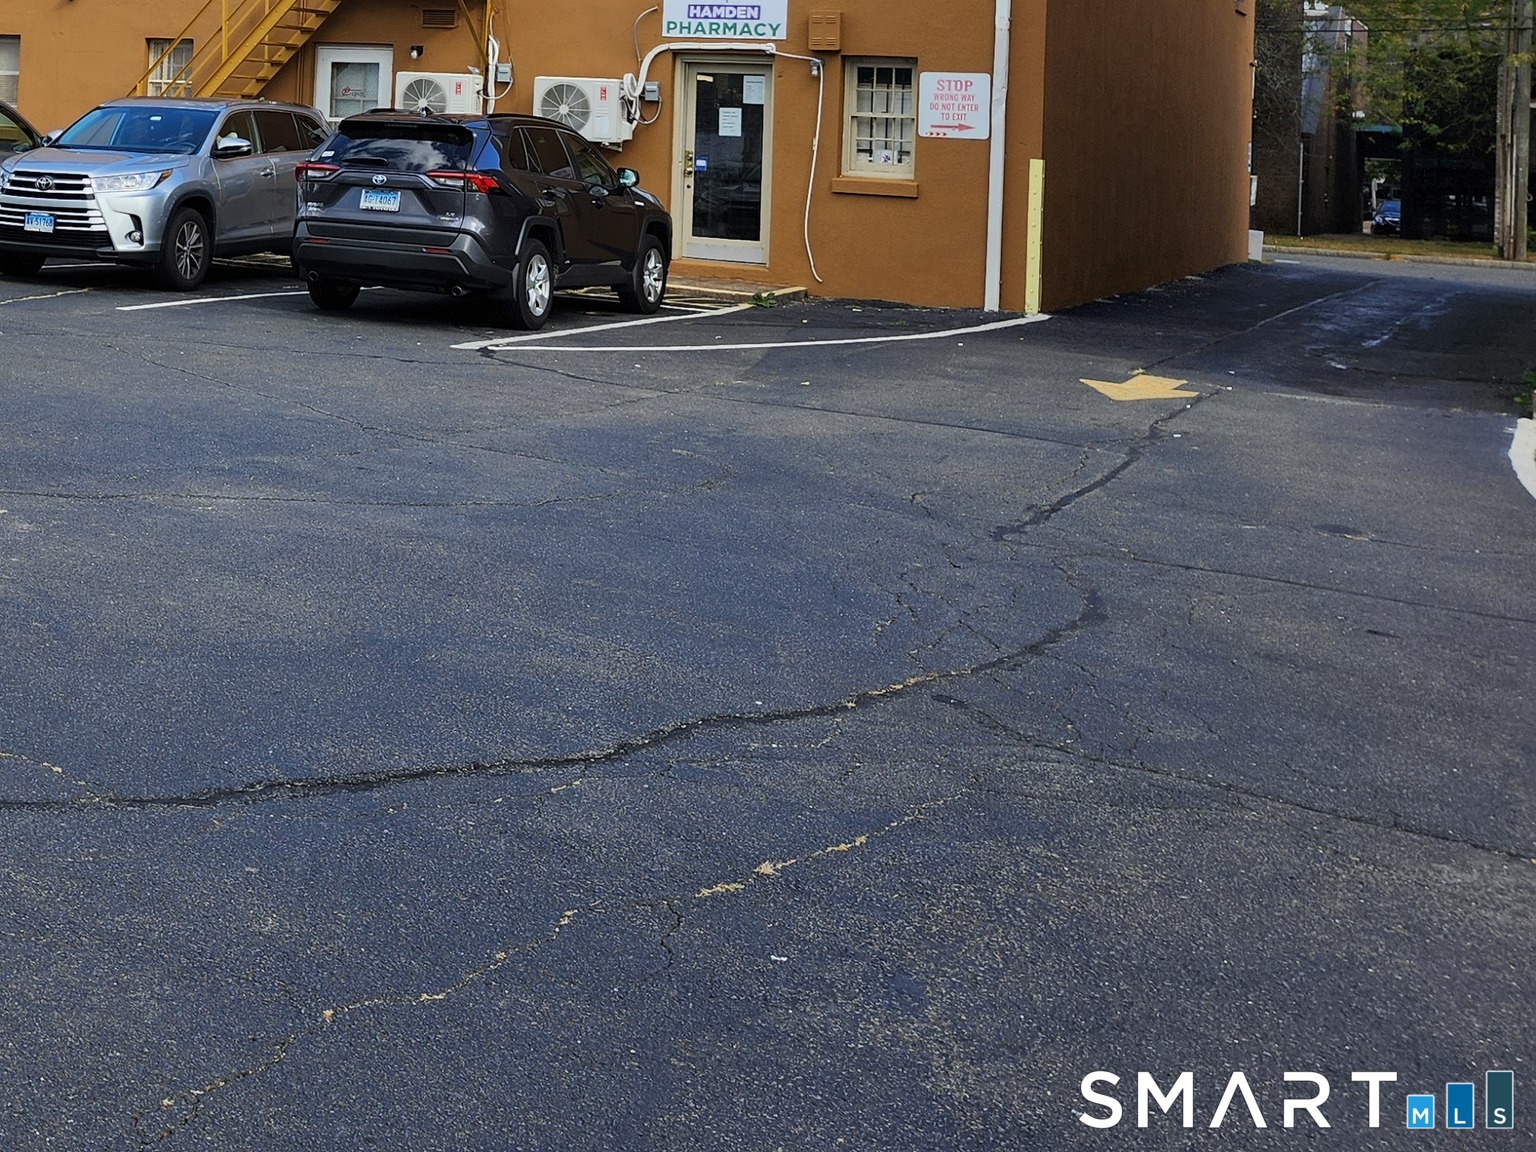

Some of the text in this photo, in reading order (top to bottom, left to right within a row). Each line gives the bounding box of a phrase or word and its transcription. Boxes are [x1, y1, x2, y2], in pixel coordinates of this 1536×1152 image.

[689, 5, 759, 19] HAMDEN
[666, 21, 781, 37] PHARMACY
[936, 79, 974, 92] STOP
[934, 93, 976, 102] WRONG WAY
[929, 102, 980, 112] DO NOT ENTER
[941, 112, 968, 121] TO EXIT
